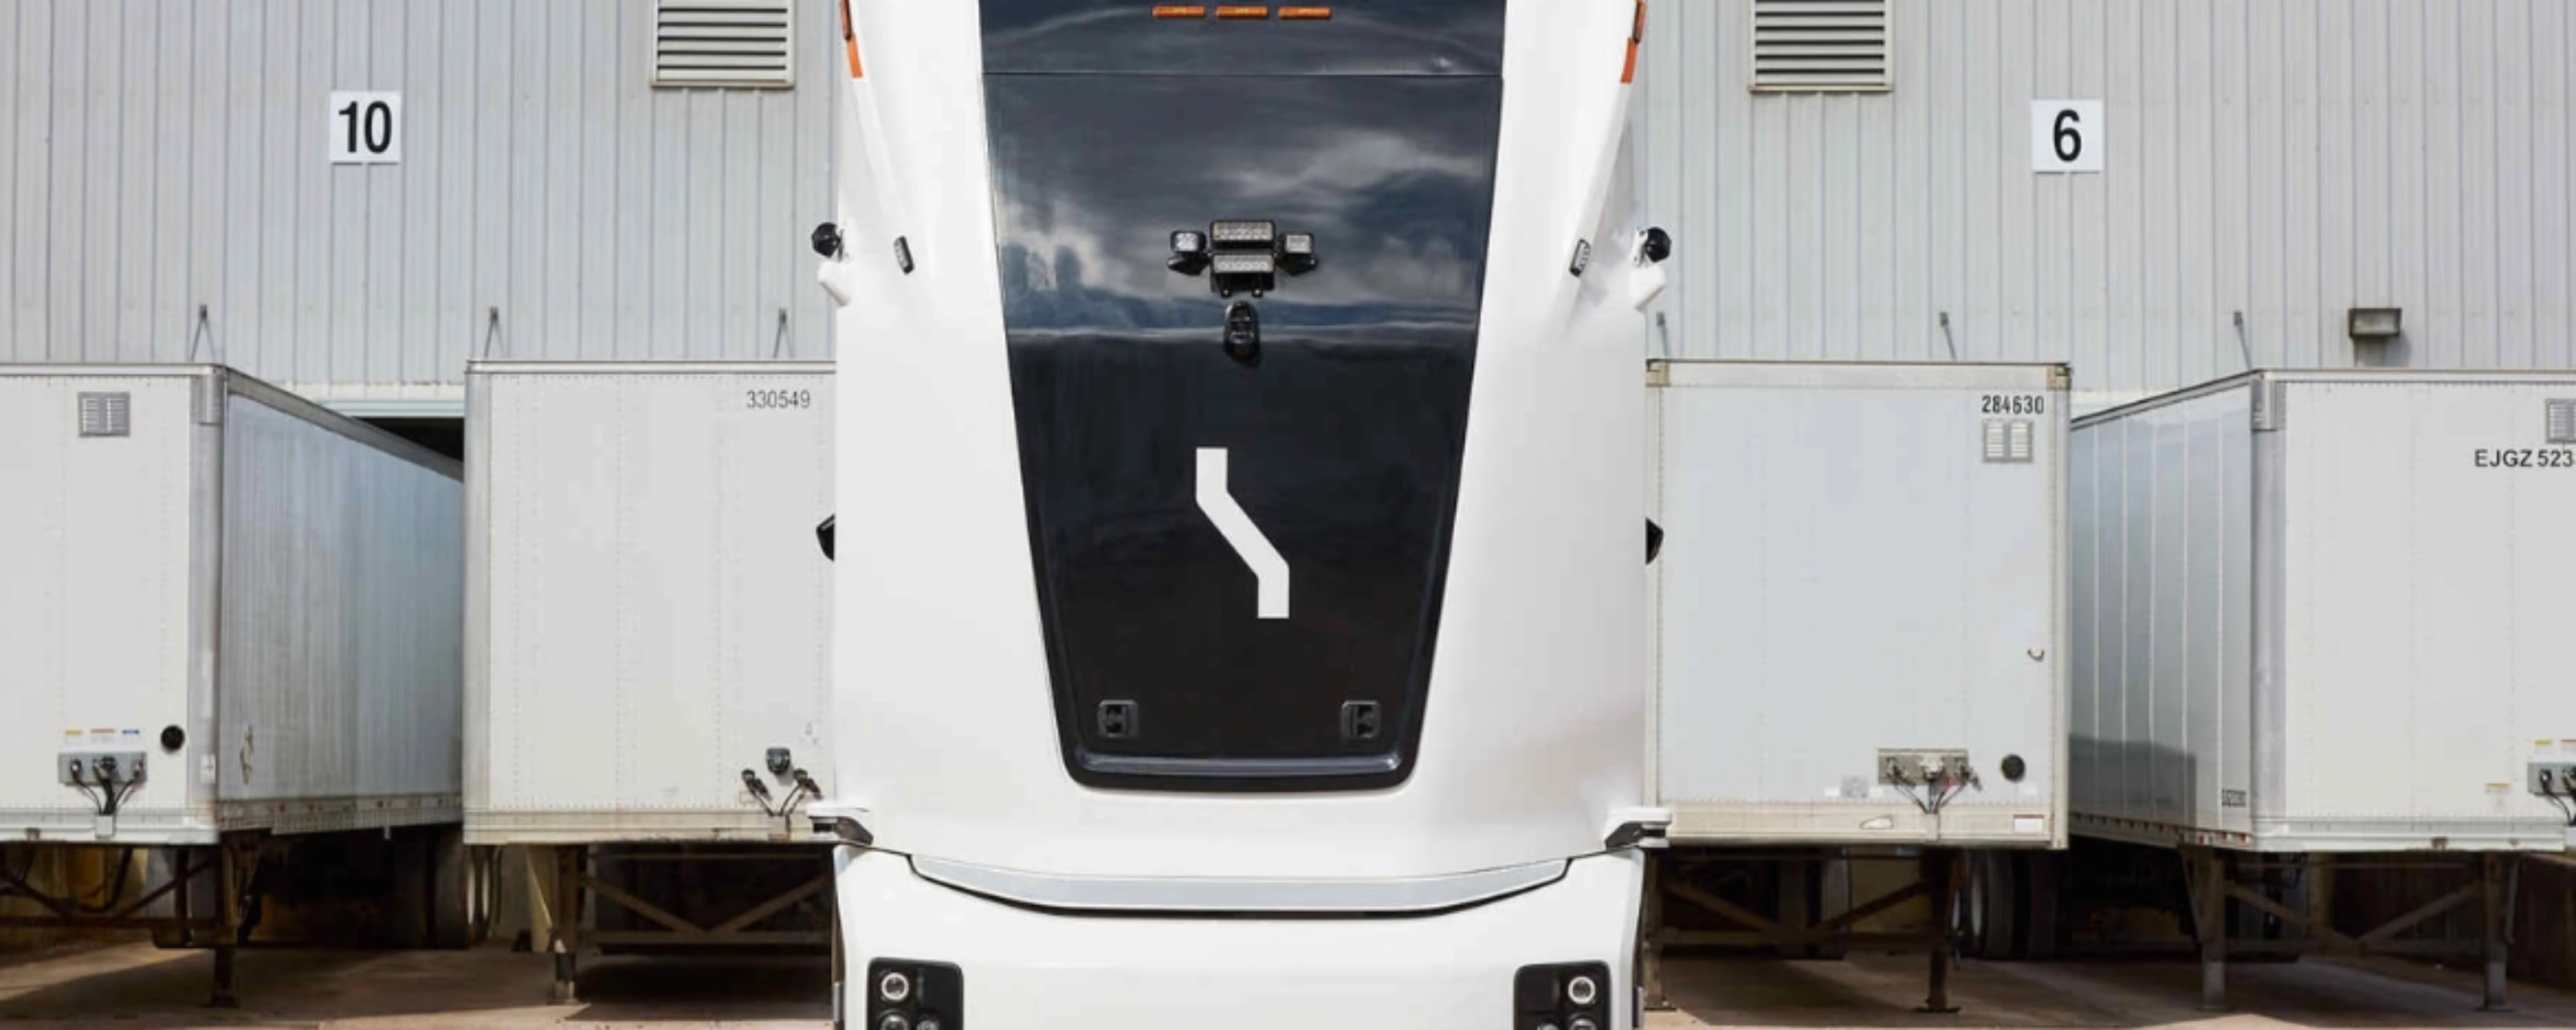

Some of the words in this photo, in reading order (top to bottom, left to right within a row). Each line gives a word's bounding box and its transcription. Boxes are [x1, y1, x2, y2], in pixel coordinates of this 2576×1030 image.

[338, 101, 392, 154] 10
[2053, 109, 2082, 163] 6
[745, 389, 811, 410] 330549
[1981, 394, 2045, 414] 284630
[2475, 449, 2533, 468] EJGZ
